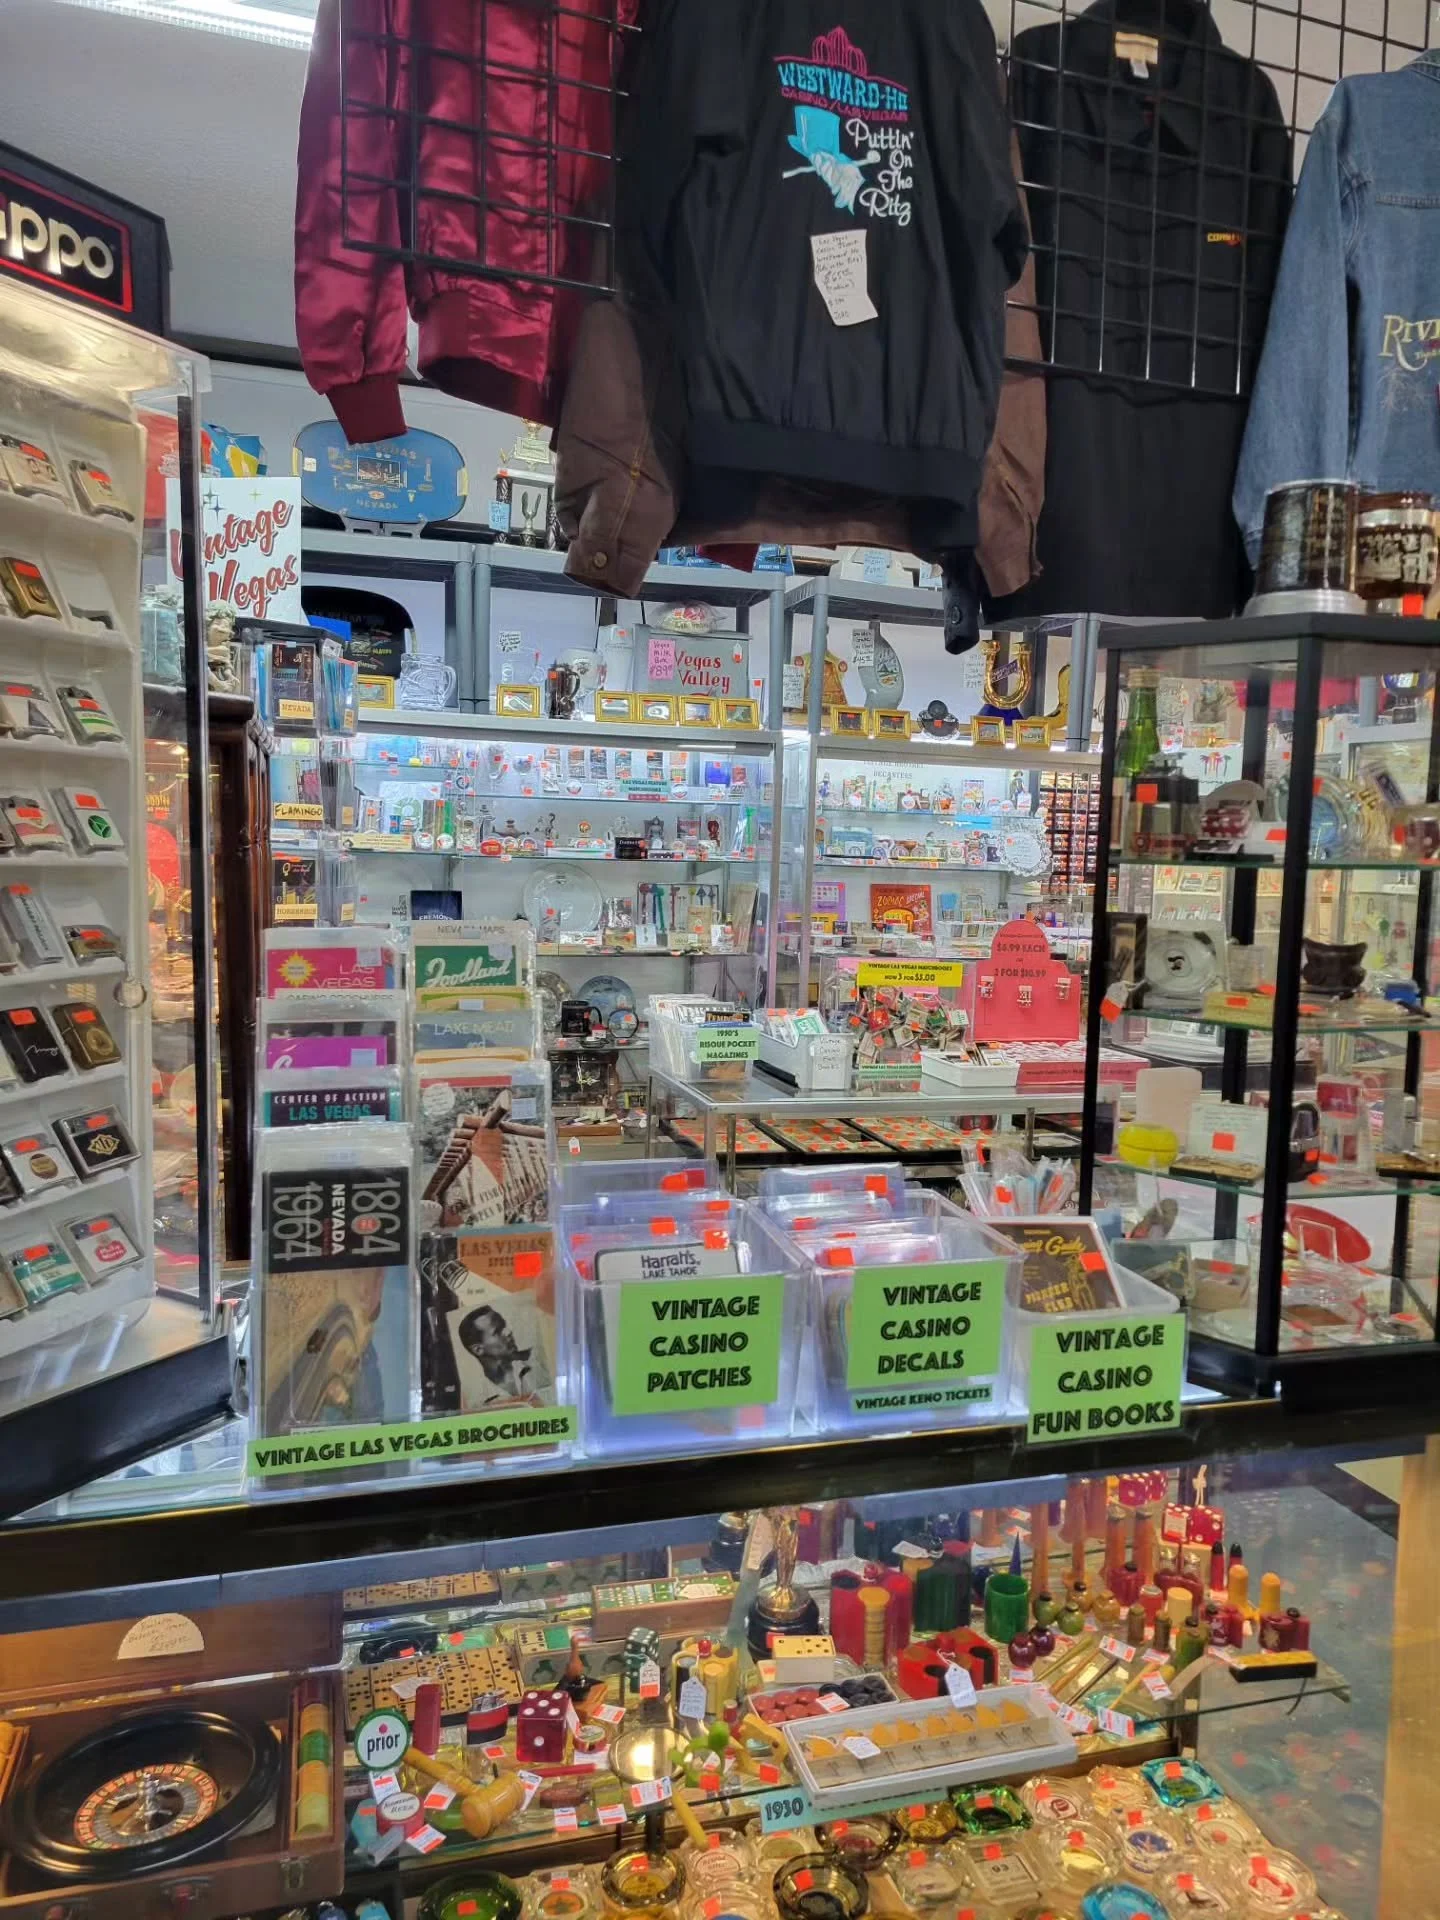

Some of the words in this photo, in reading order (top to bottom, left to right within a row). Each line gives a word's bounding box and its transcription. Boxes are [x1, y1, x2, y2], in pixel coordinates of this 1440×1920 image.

[777, 62, 908, 111] WESTWARD-HO
[846, 118, 914, 149] Puttin'
[889, 150, 913, 169] On
[878, 170, 913, 194] The
[859, 188, 911, 226] Ritz
[170, 499, 290, 581] Vntage
[208, 554, 299, 619] Vegas
[674, 650, 721, 671] Vegas
[679, 670, 730, 694] Valley
[275, 804, 322, 815] FLAMINGO
[438, 926, 477, 934] NEVA
[313, 977, 376, 989] VEGAS
[1000, 968, 1019, 977] FOR
[706, 1051, 749, 1059] MAGAZINES
[727, 1040, 757, 1048] POCKET
[274, 1094, 317, 1104] CENTER
[324, 1094, 338, 1103] OF
[344, 1092, 386, 1102] ACTION
[289, 1105, 318, 1121] LAS
[324, 1103, 371, 1119] VEGAS
[272, 1181, 323, 1261] 1964
[331, 1183, 346, 1255] NEVADA
[642, 1268, 666, 1279] LAKE
[669, 1266, 698, 1277] TAHOE
[884, 1281, 982, 1306] VINTAGE
[652, 1295, 760, 1321] VINTAGE
[880, 1316, 971, 1341] CASINO
[1056, 1324, 1165, 1354] VINTAGE
[650, 1331, 749, 1357] CASINO
[878, 1349, 965, 1375] DECALS
[647, 1365, 752, 1393] PATCHES
[1058, 1364, 1154, 1394] CASINO
[855, 1394, 906, 1410] VINTAGE
[909, 1391, 943, 1405] KENO
[945, 1387, 991, 1401] TICKETS
[1032, 1408, 1081, 1435] FUN
[1087, 1400, 1175, 1428] BOOKS
[255, 1442, 345, 1468] VINTAGE
[350, 1437, 386, 1457] LAS
[389, 1429, 454, 1453] VEGAS
[457, 1416, 571, 1446] BROCHURES
[366, 1732, 401, 1761] prior
[764, 1796, 804, 1822] 1930
